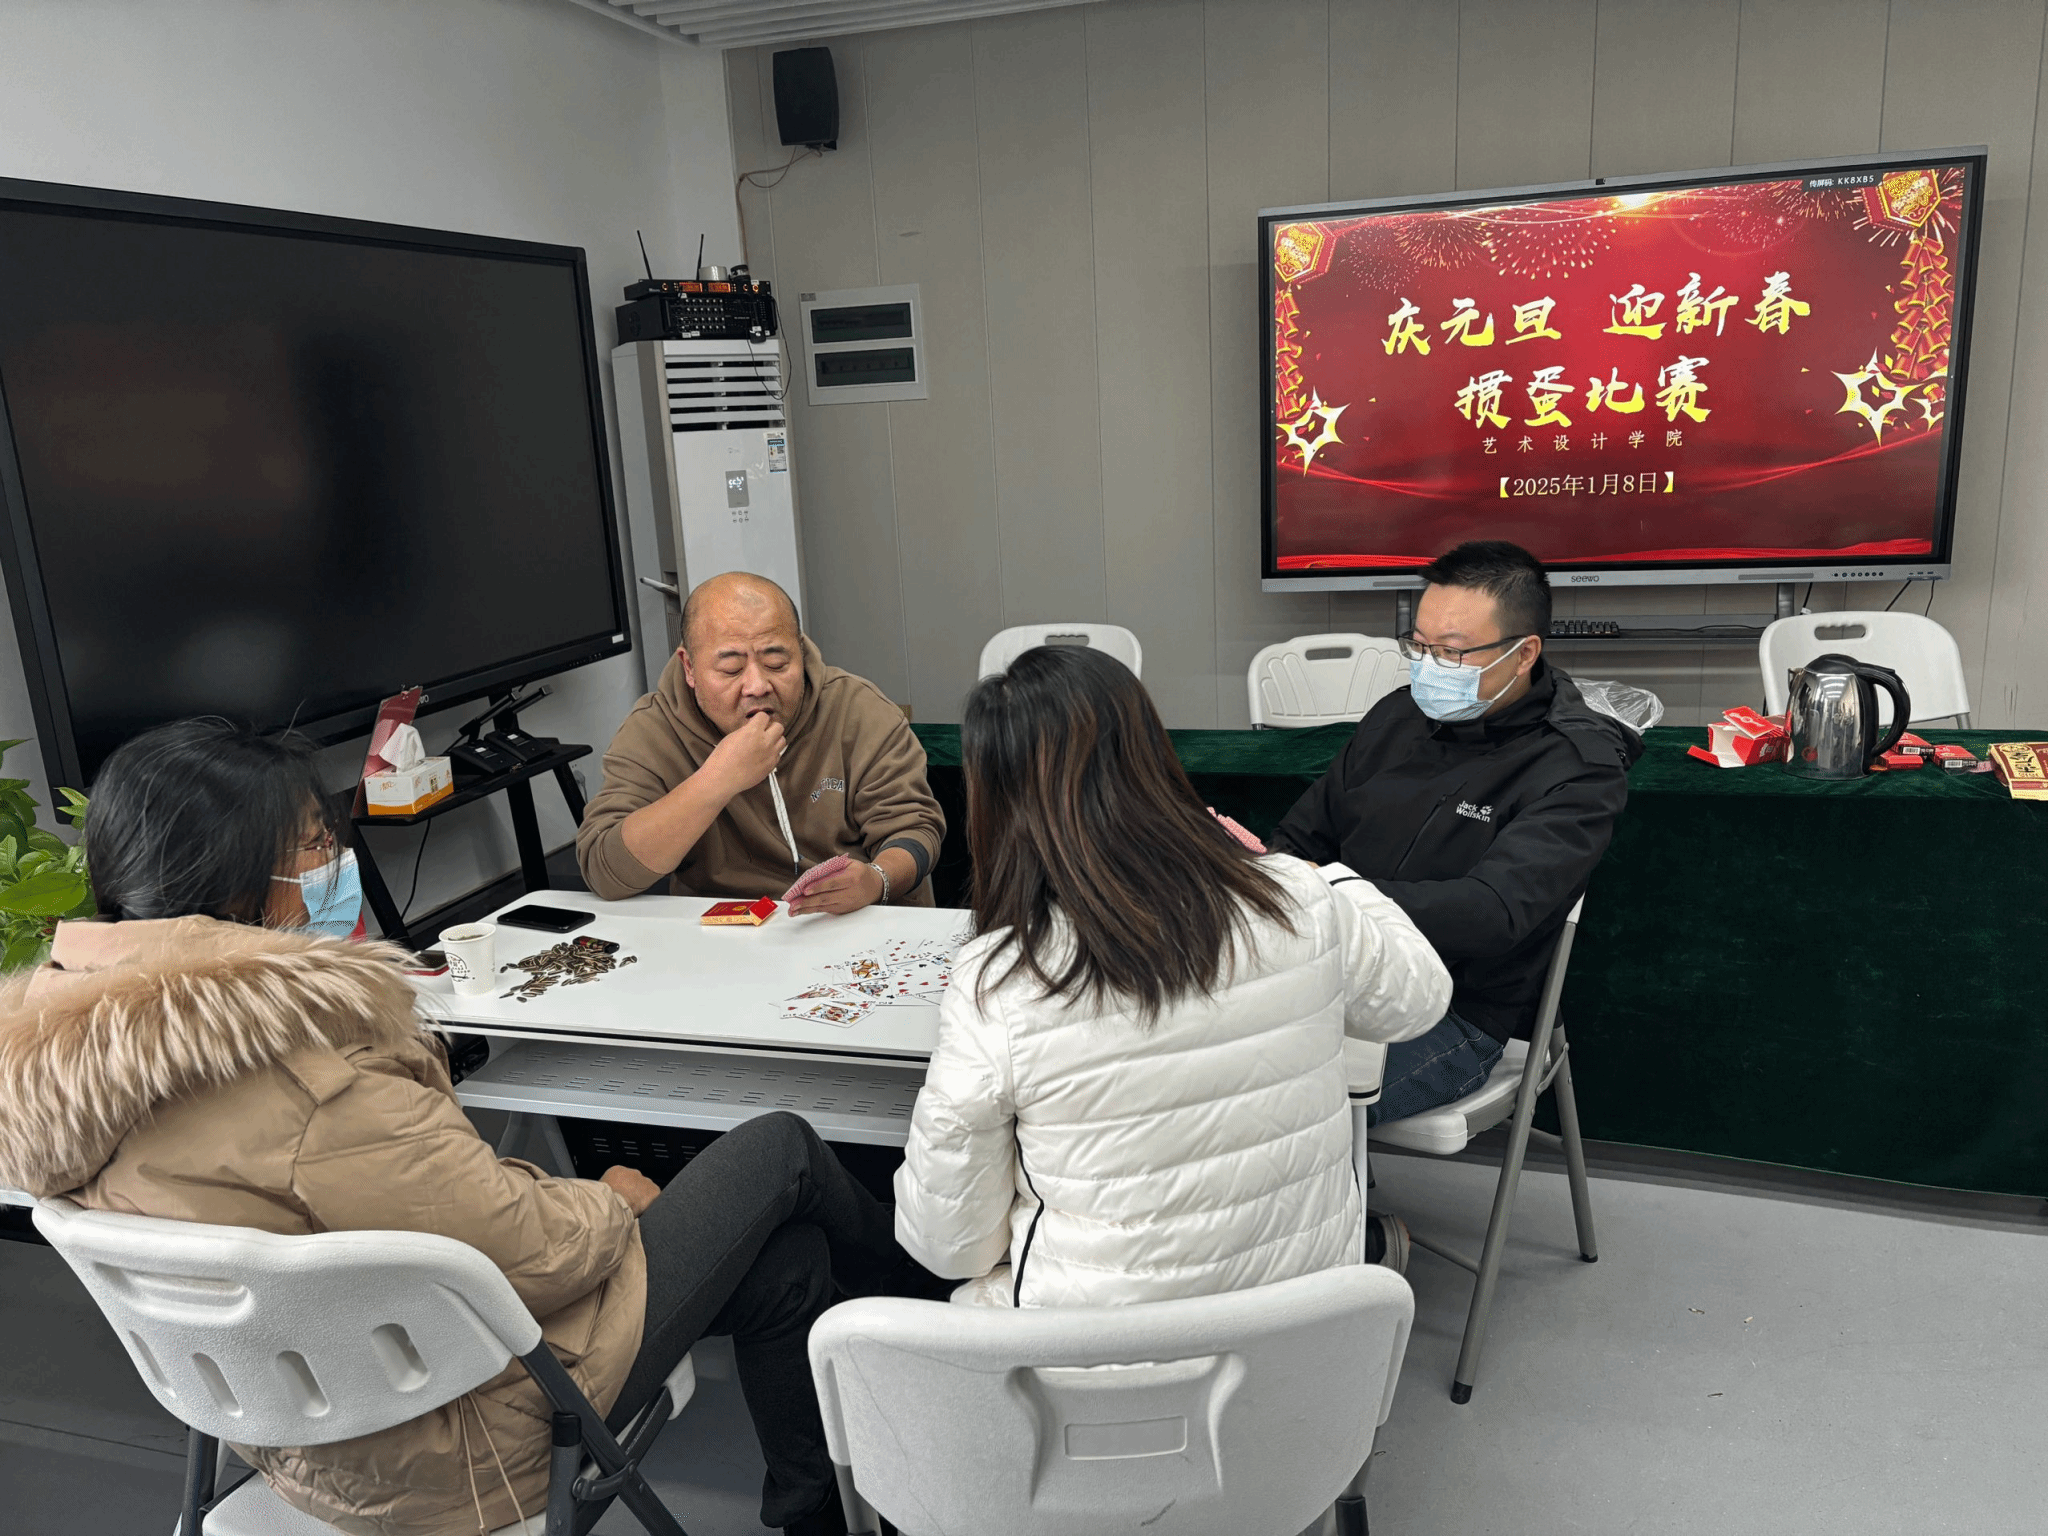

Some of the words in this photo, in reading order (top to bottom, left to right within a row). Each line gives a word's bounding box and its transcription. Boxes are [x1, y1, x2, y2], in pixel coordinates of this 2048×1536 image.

[1381, 296, 1562, 355] 庆元旦
[1602, 271, 1811, 340] 迎新春
[1454, 355, 1712, 429] 掼蛋比赛
[1482, 429, 1683, 455] 艺术设计学院
[1571, 575, 1600, 583] seewo
[1456, 806, 1491, 823] Wolfskin
[1459, 800, 1479, 811] Jack
